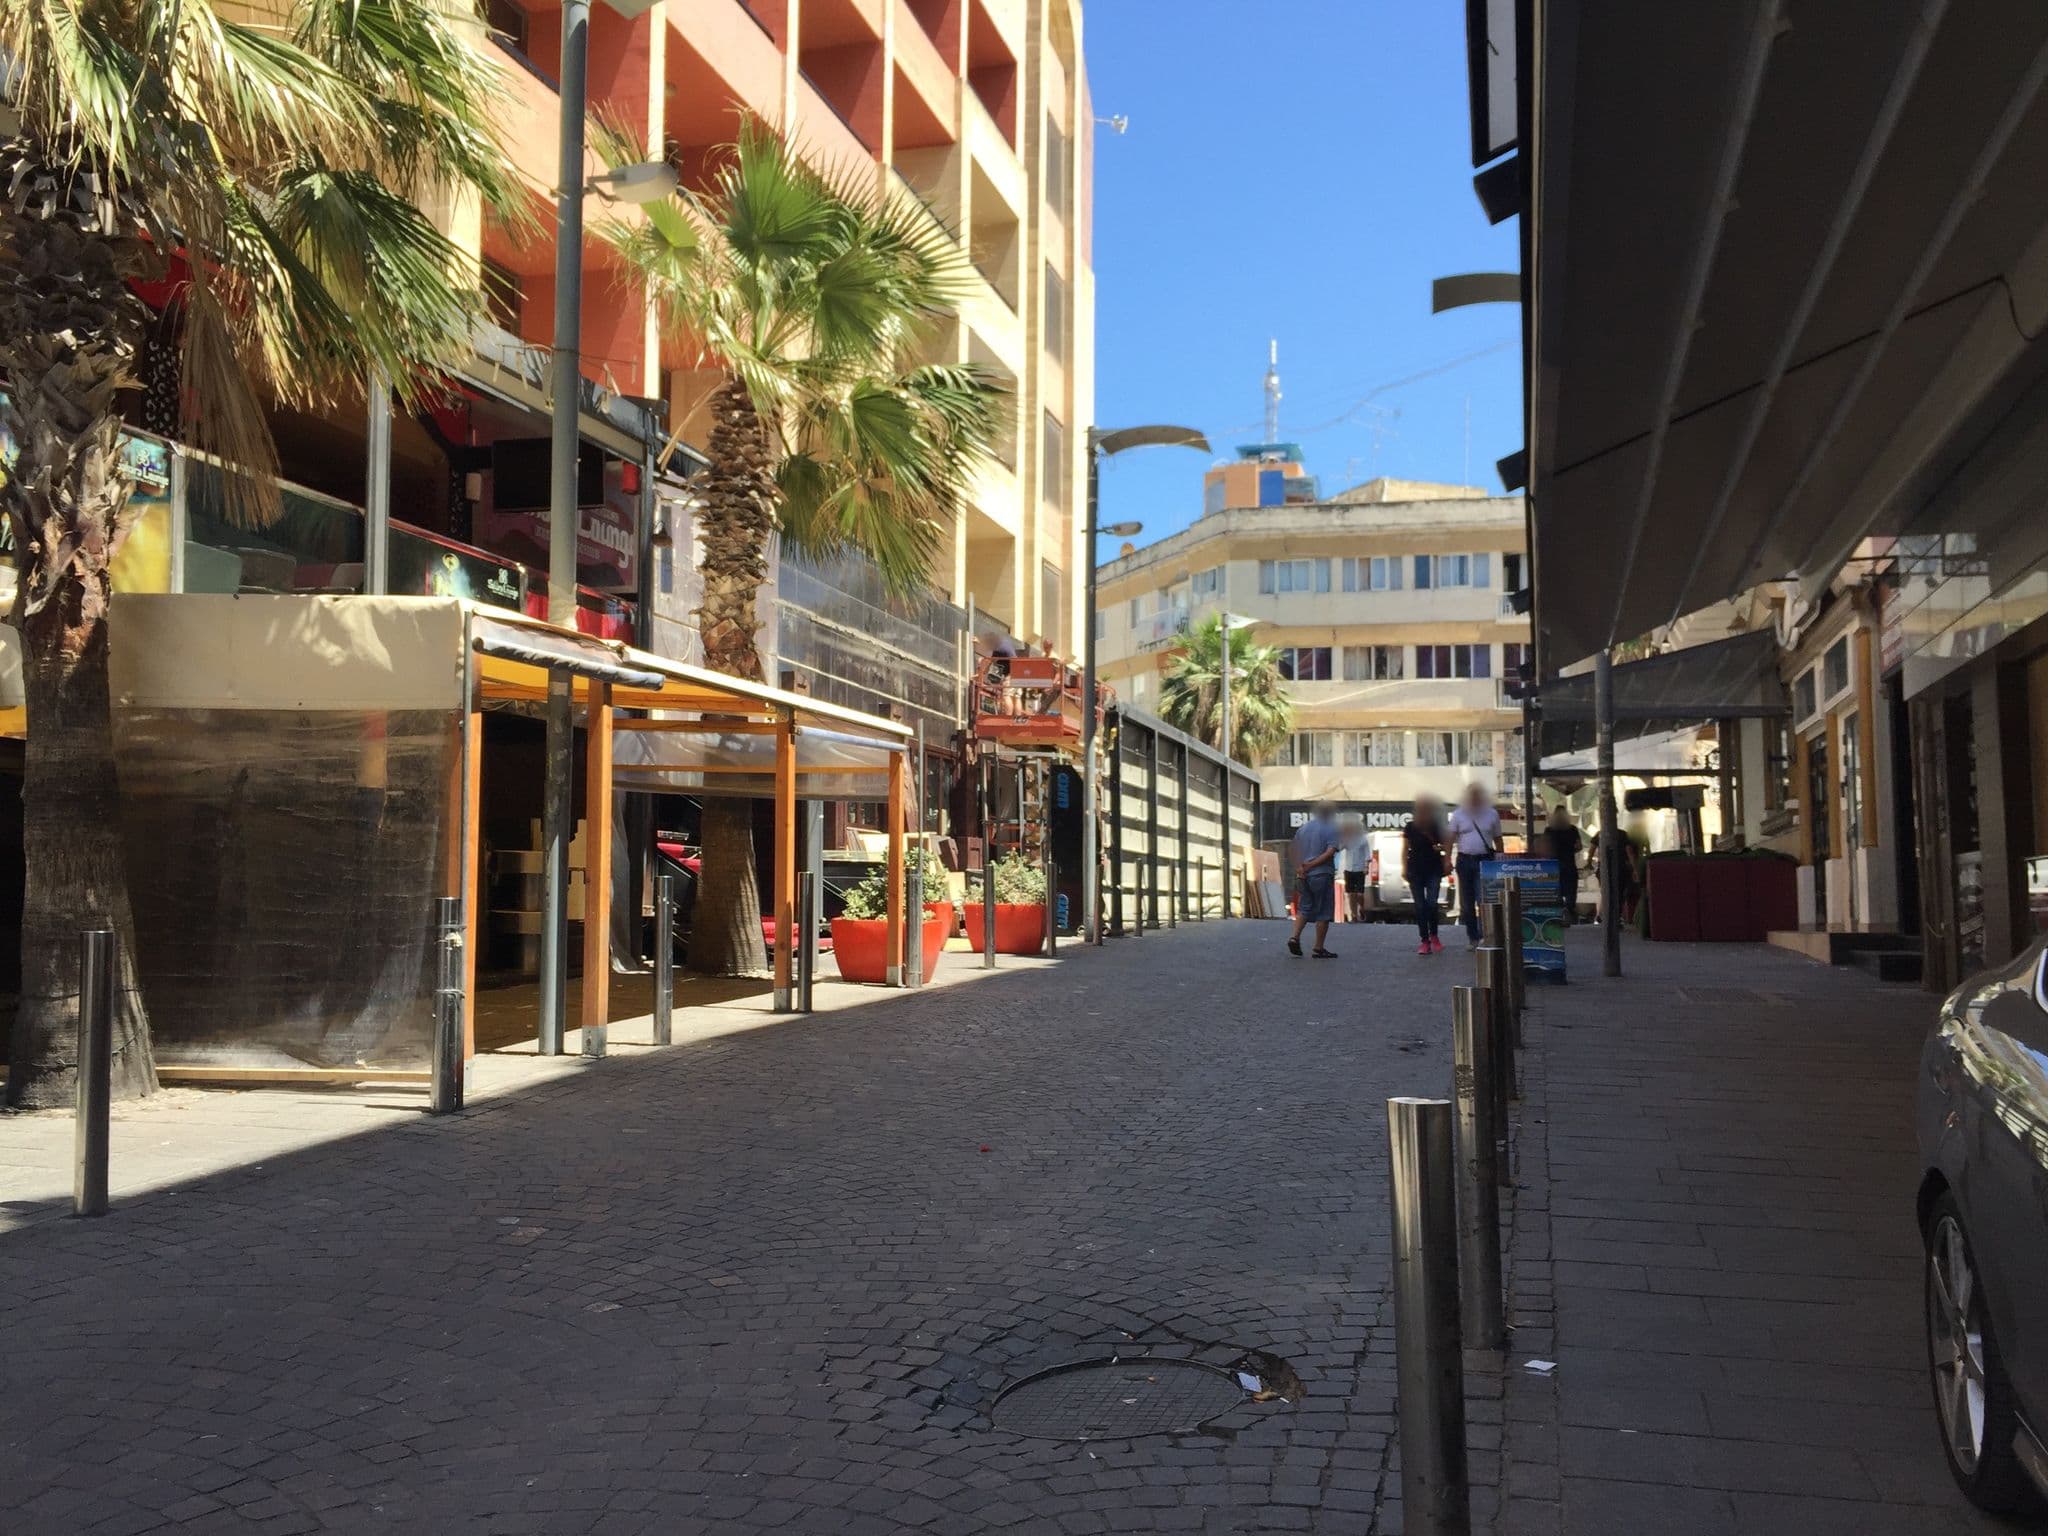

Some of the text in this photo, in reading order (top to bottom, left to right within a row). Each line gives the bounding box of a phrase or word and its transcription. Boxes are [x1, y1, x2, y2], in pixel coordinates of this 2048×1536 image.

[1367, 812, 1415, 828] KING
[1501, 863, 1533, 871] Comino
[1517, 872, 1549, 880] Lagoon
